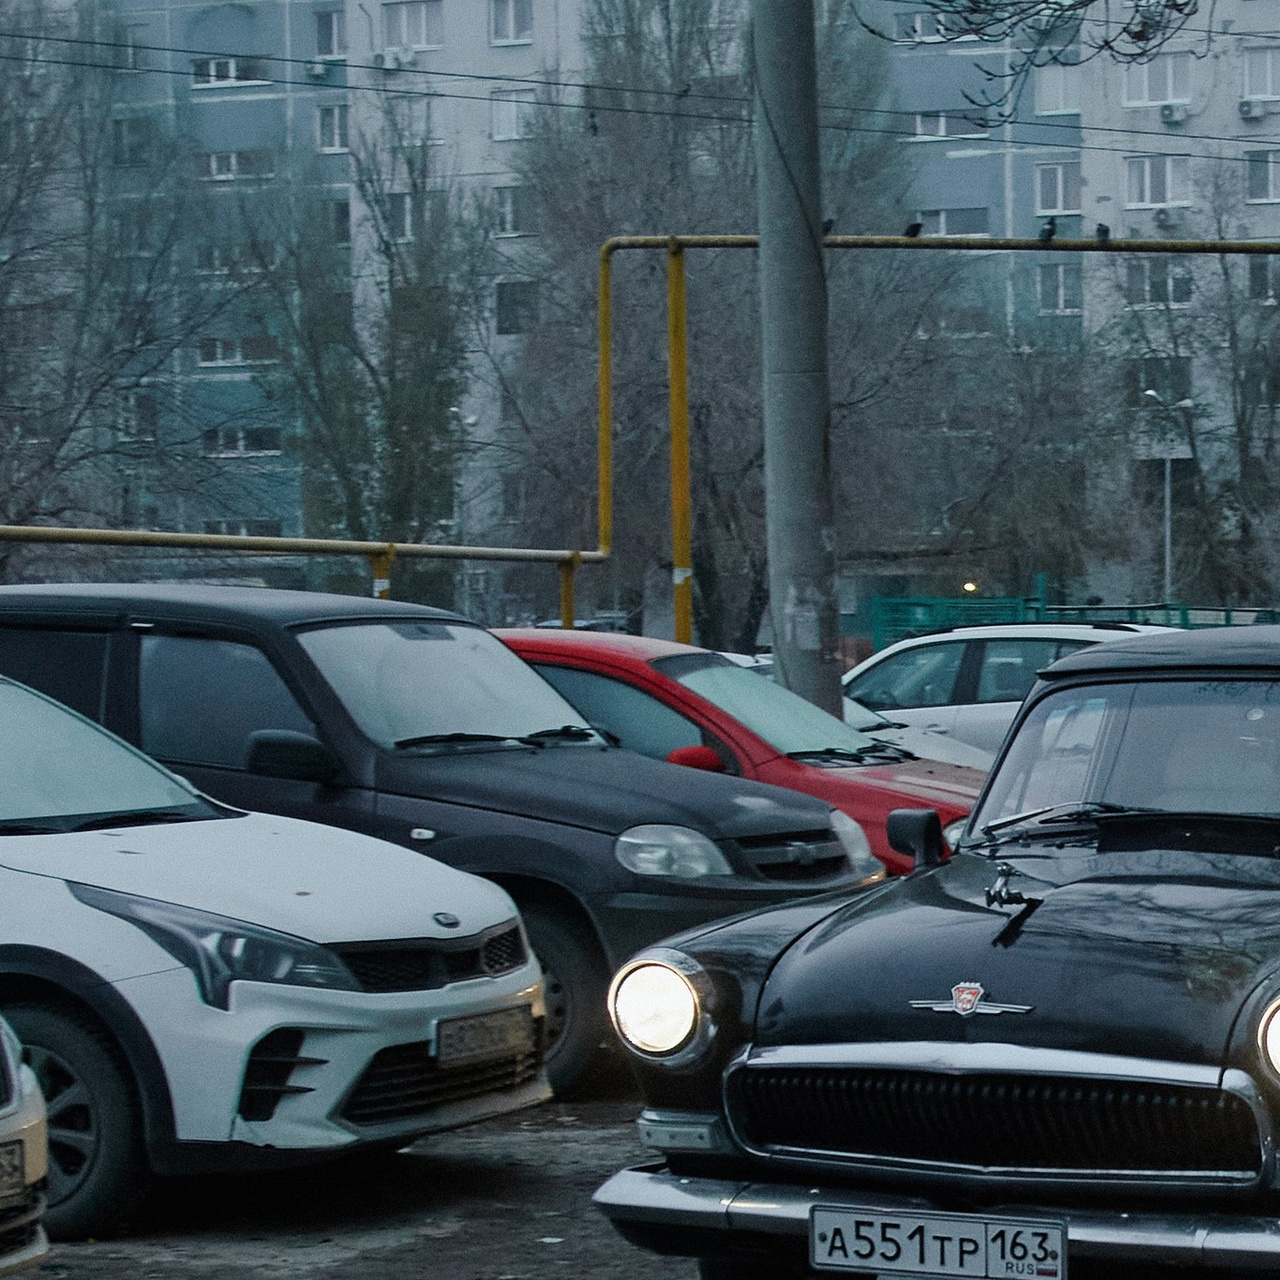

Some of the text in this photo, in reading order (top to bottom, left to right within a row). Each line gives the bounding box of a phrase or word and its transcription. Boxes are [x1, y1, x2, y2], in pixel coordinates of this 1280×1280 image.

[827, 1220, 1050, 1268] А551ТР 163
[1005, 1260, 1035, 1276] RUS
